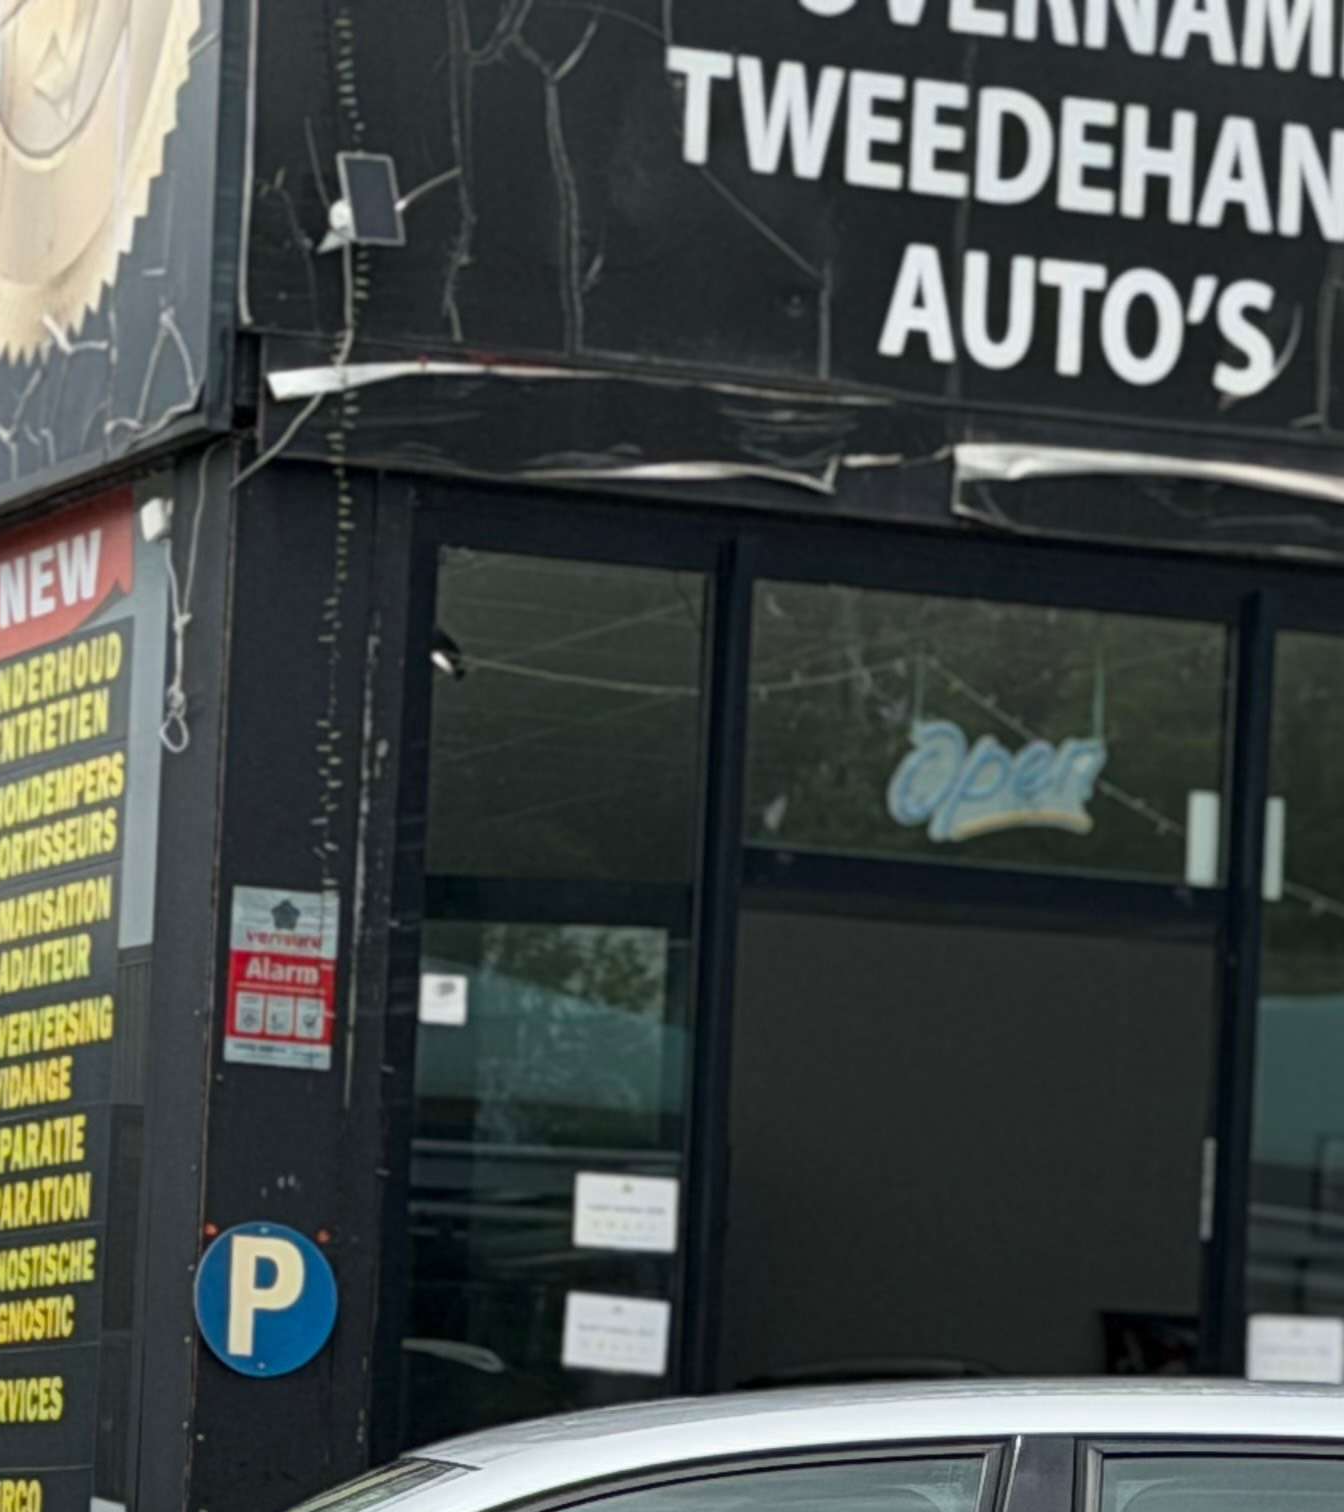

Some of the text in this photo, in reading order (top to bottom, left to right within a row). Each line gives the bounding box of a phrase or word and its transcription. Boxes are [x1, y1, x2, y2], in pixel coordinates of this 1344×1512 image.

[877, 243, 1277, 398] AUTO'S
[886, 720, 1108, 842] Open
[245, 956, 321, 986] Alarm
[228, 1235, 305, 1357] P
